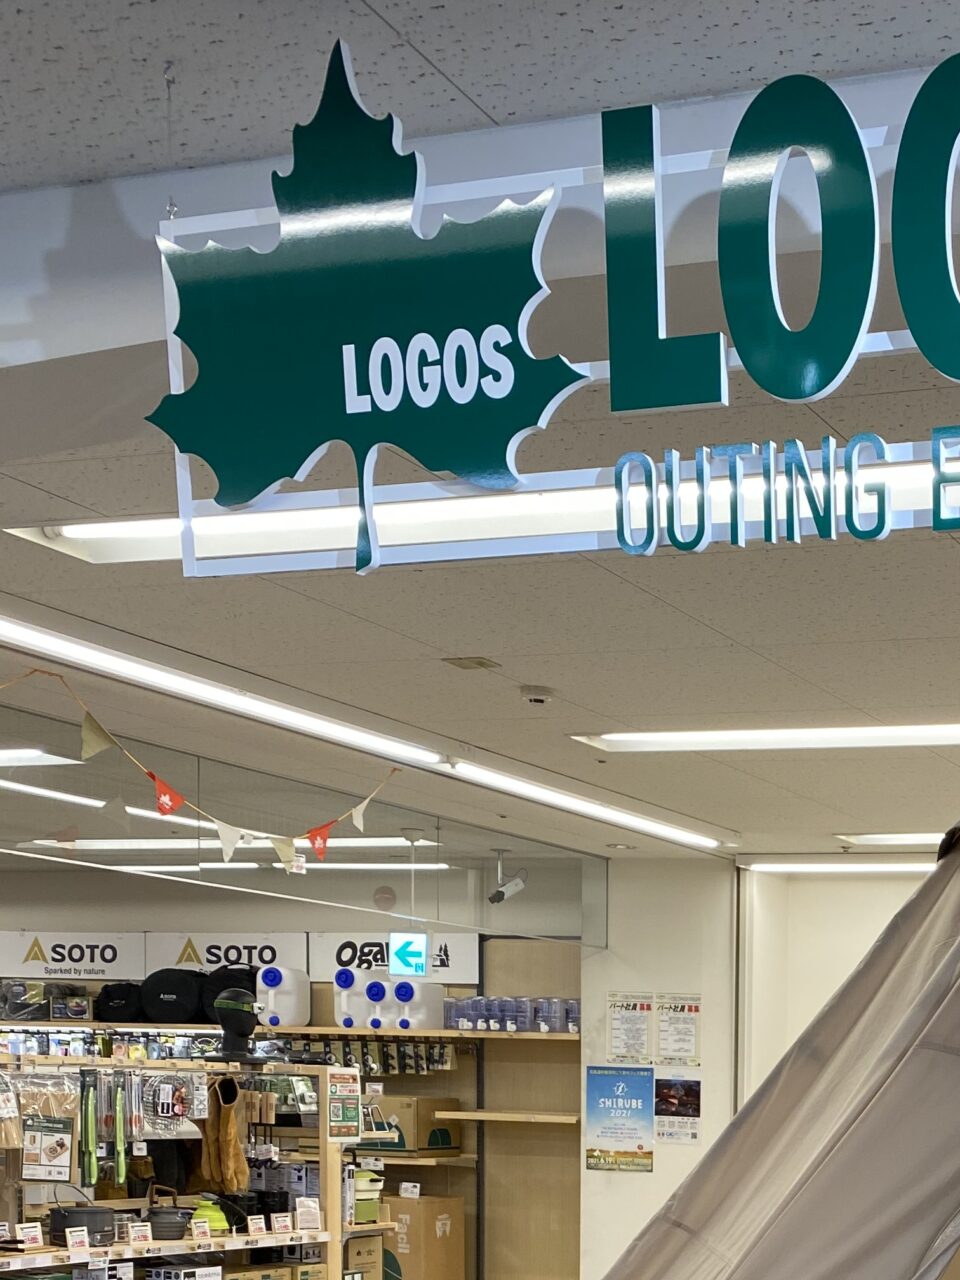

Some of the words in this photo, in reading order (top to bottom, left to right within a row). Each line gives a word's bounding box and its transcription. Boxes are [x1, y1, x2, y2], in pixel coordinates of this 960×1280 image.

[343, 324, 515, 414] LOGOS
[615, 432, 890, 557] OUTING
[51, 944, 118, 964] SOTO
[206, 944, 277, 965] SOTO
[44, 967, 72, 977] Sparked
[74, 967, 82, 977] by
[83, 967, 106, 976] nature
[599, 1098, 643, 1110] SHIRUBE
[610, 1109, 631, 1118] 2021
